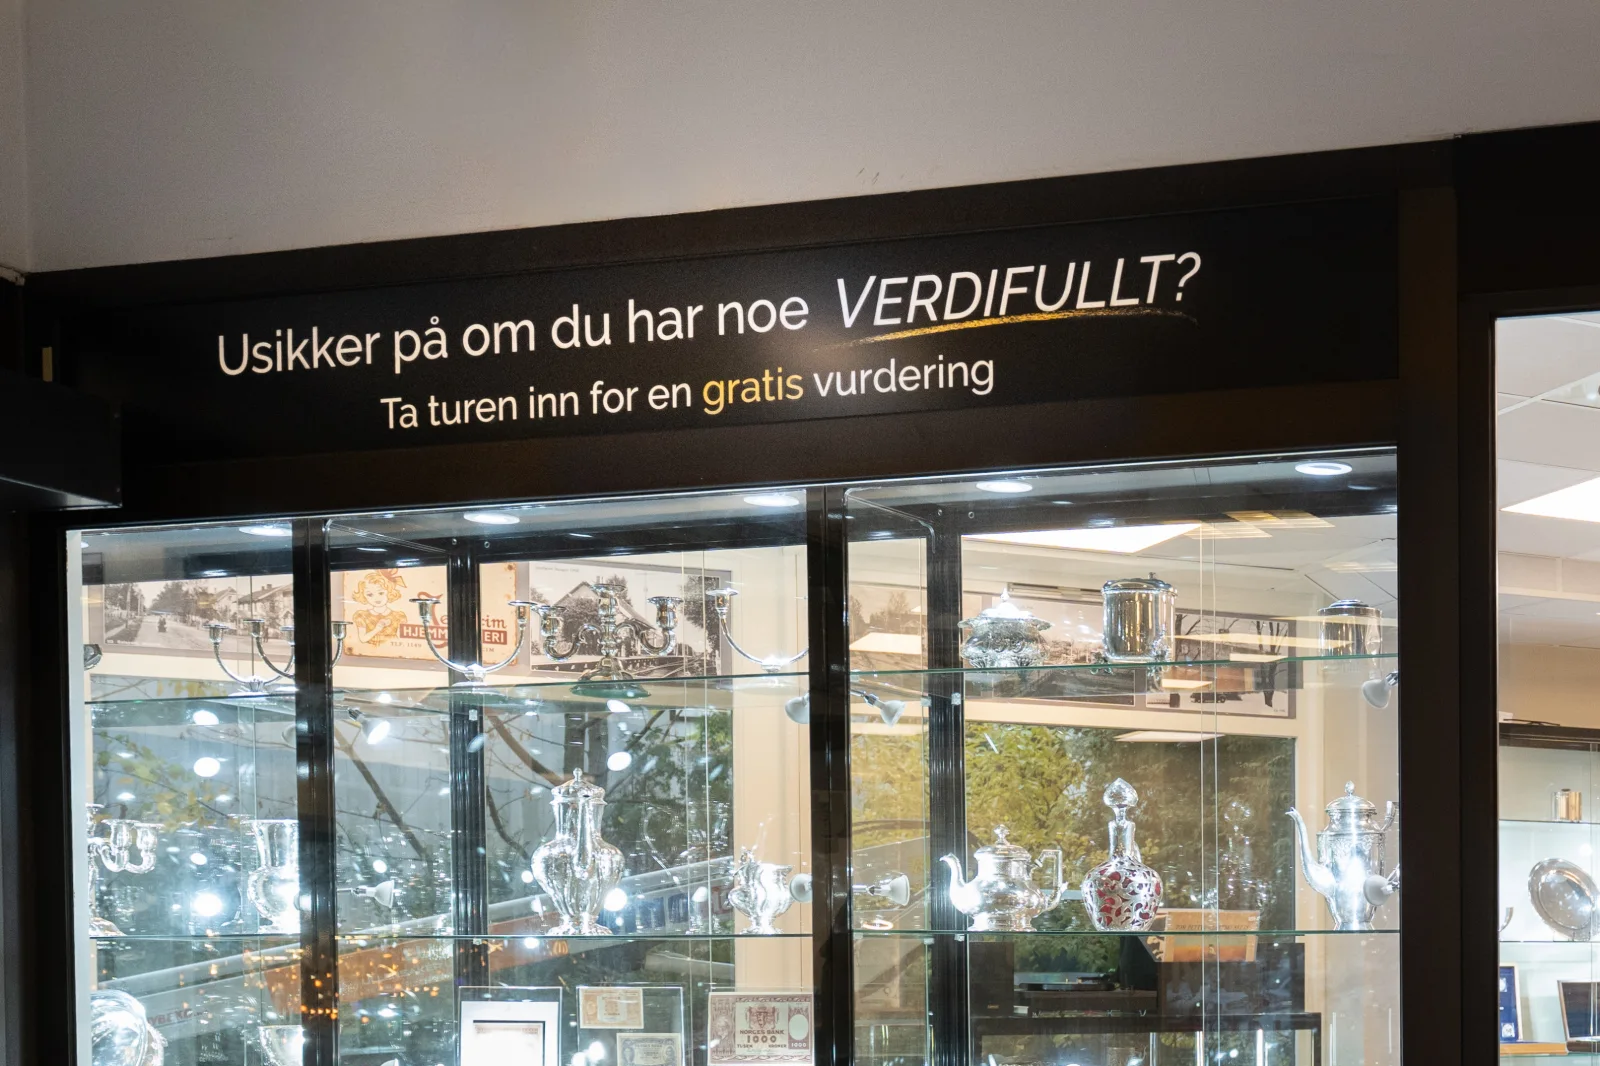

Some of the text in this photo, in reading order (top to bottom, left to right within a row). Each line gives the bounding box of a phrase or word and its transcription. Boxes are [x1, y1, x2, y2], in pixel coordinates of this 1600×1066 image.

[218, 251, 1202, 376] Usikker på om du har noe VERDIFULLT?
[380, 354, 995, 429] Ta turen inn for en gratis vurdering
[403, 626, 506, 643] HJEMMERI
[747, 1035, 777, 1043] 1000
